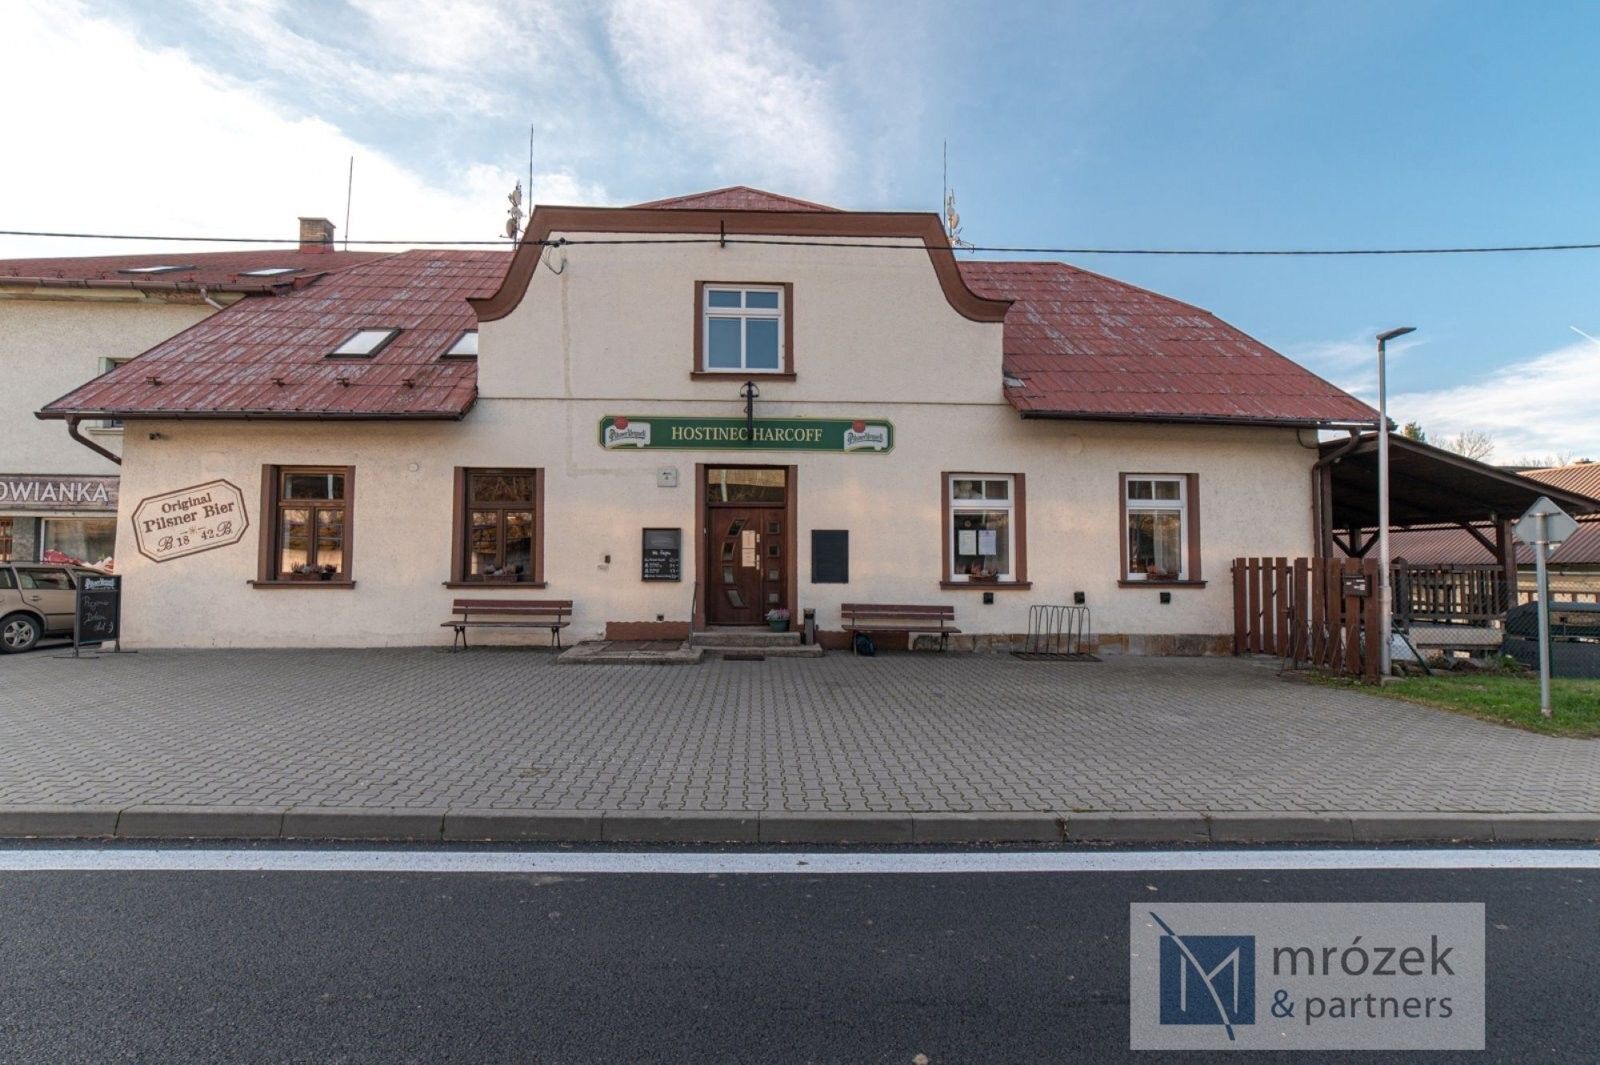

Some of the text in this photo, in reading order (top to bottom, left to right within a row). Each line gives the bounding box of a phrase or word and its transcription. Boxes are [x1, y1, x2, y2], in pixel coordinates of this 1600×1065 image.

[671, 426, 823, 442] HOSTINEC HARCOFF
[161, 492, 212, 514] Original
[143, 501, 235, 533] Pilsner Bier
[176, 535, 190, 547] 18
[201, 529, 215, 541] 42
